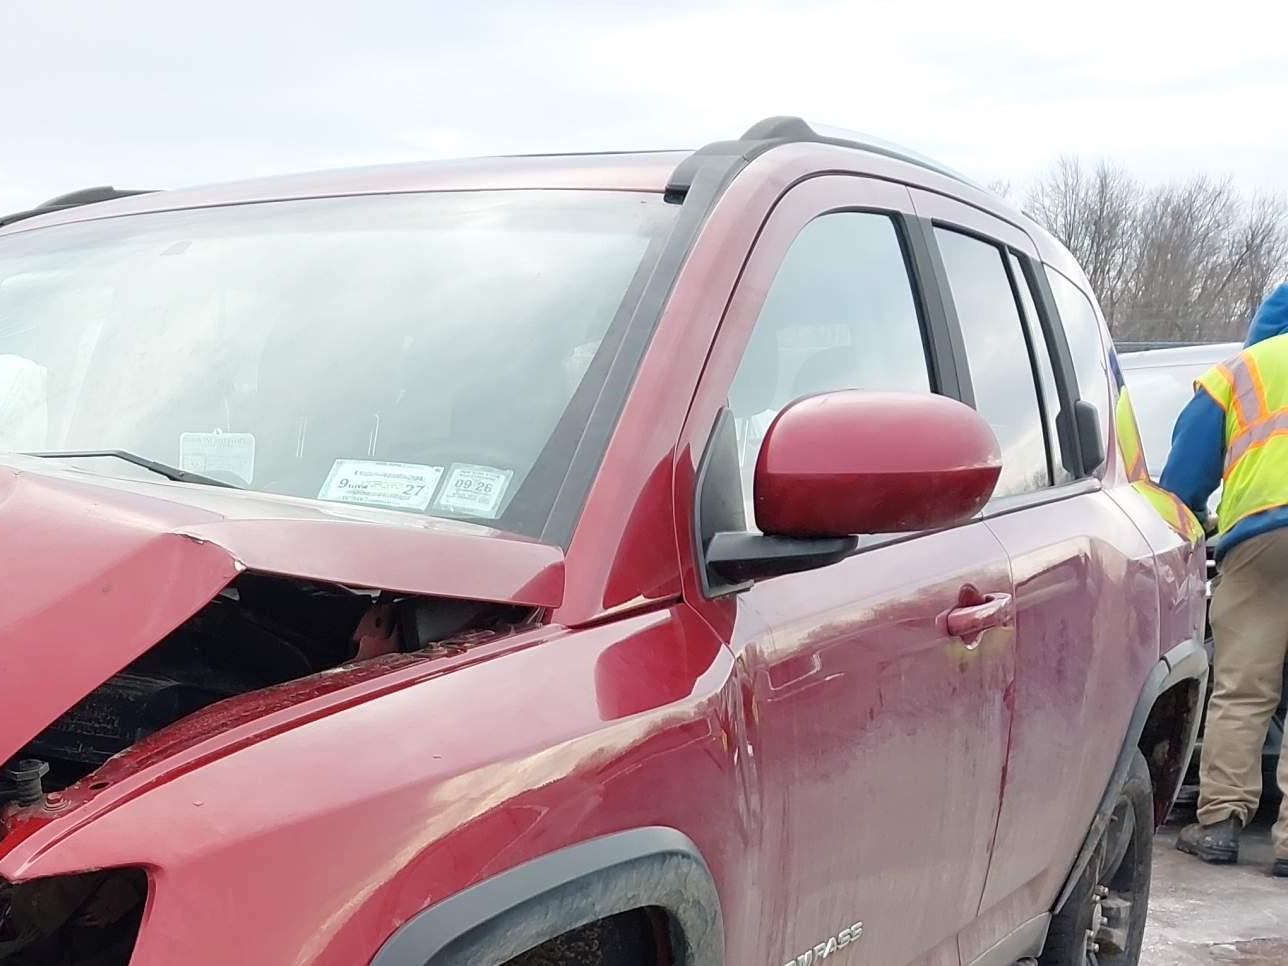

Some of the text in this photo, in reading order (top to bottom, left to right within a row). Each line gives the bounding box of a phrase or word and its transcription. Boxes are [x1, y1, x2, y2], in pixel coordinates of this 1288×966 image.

[402, 484, 425, 496] 27
[454, 479, 493, 493] 09 26
